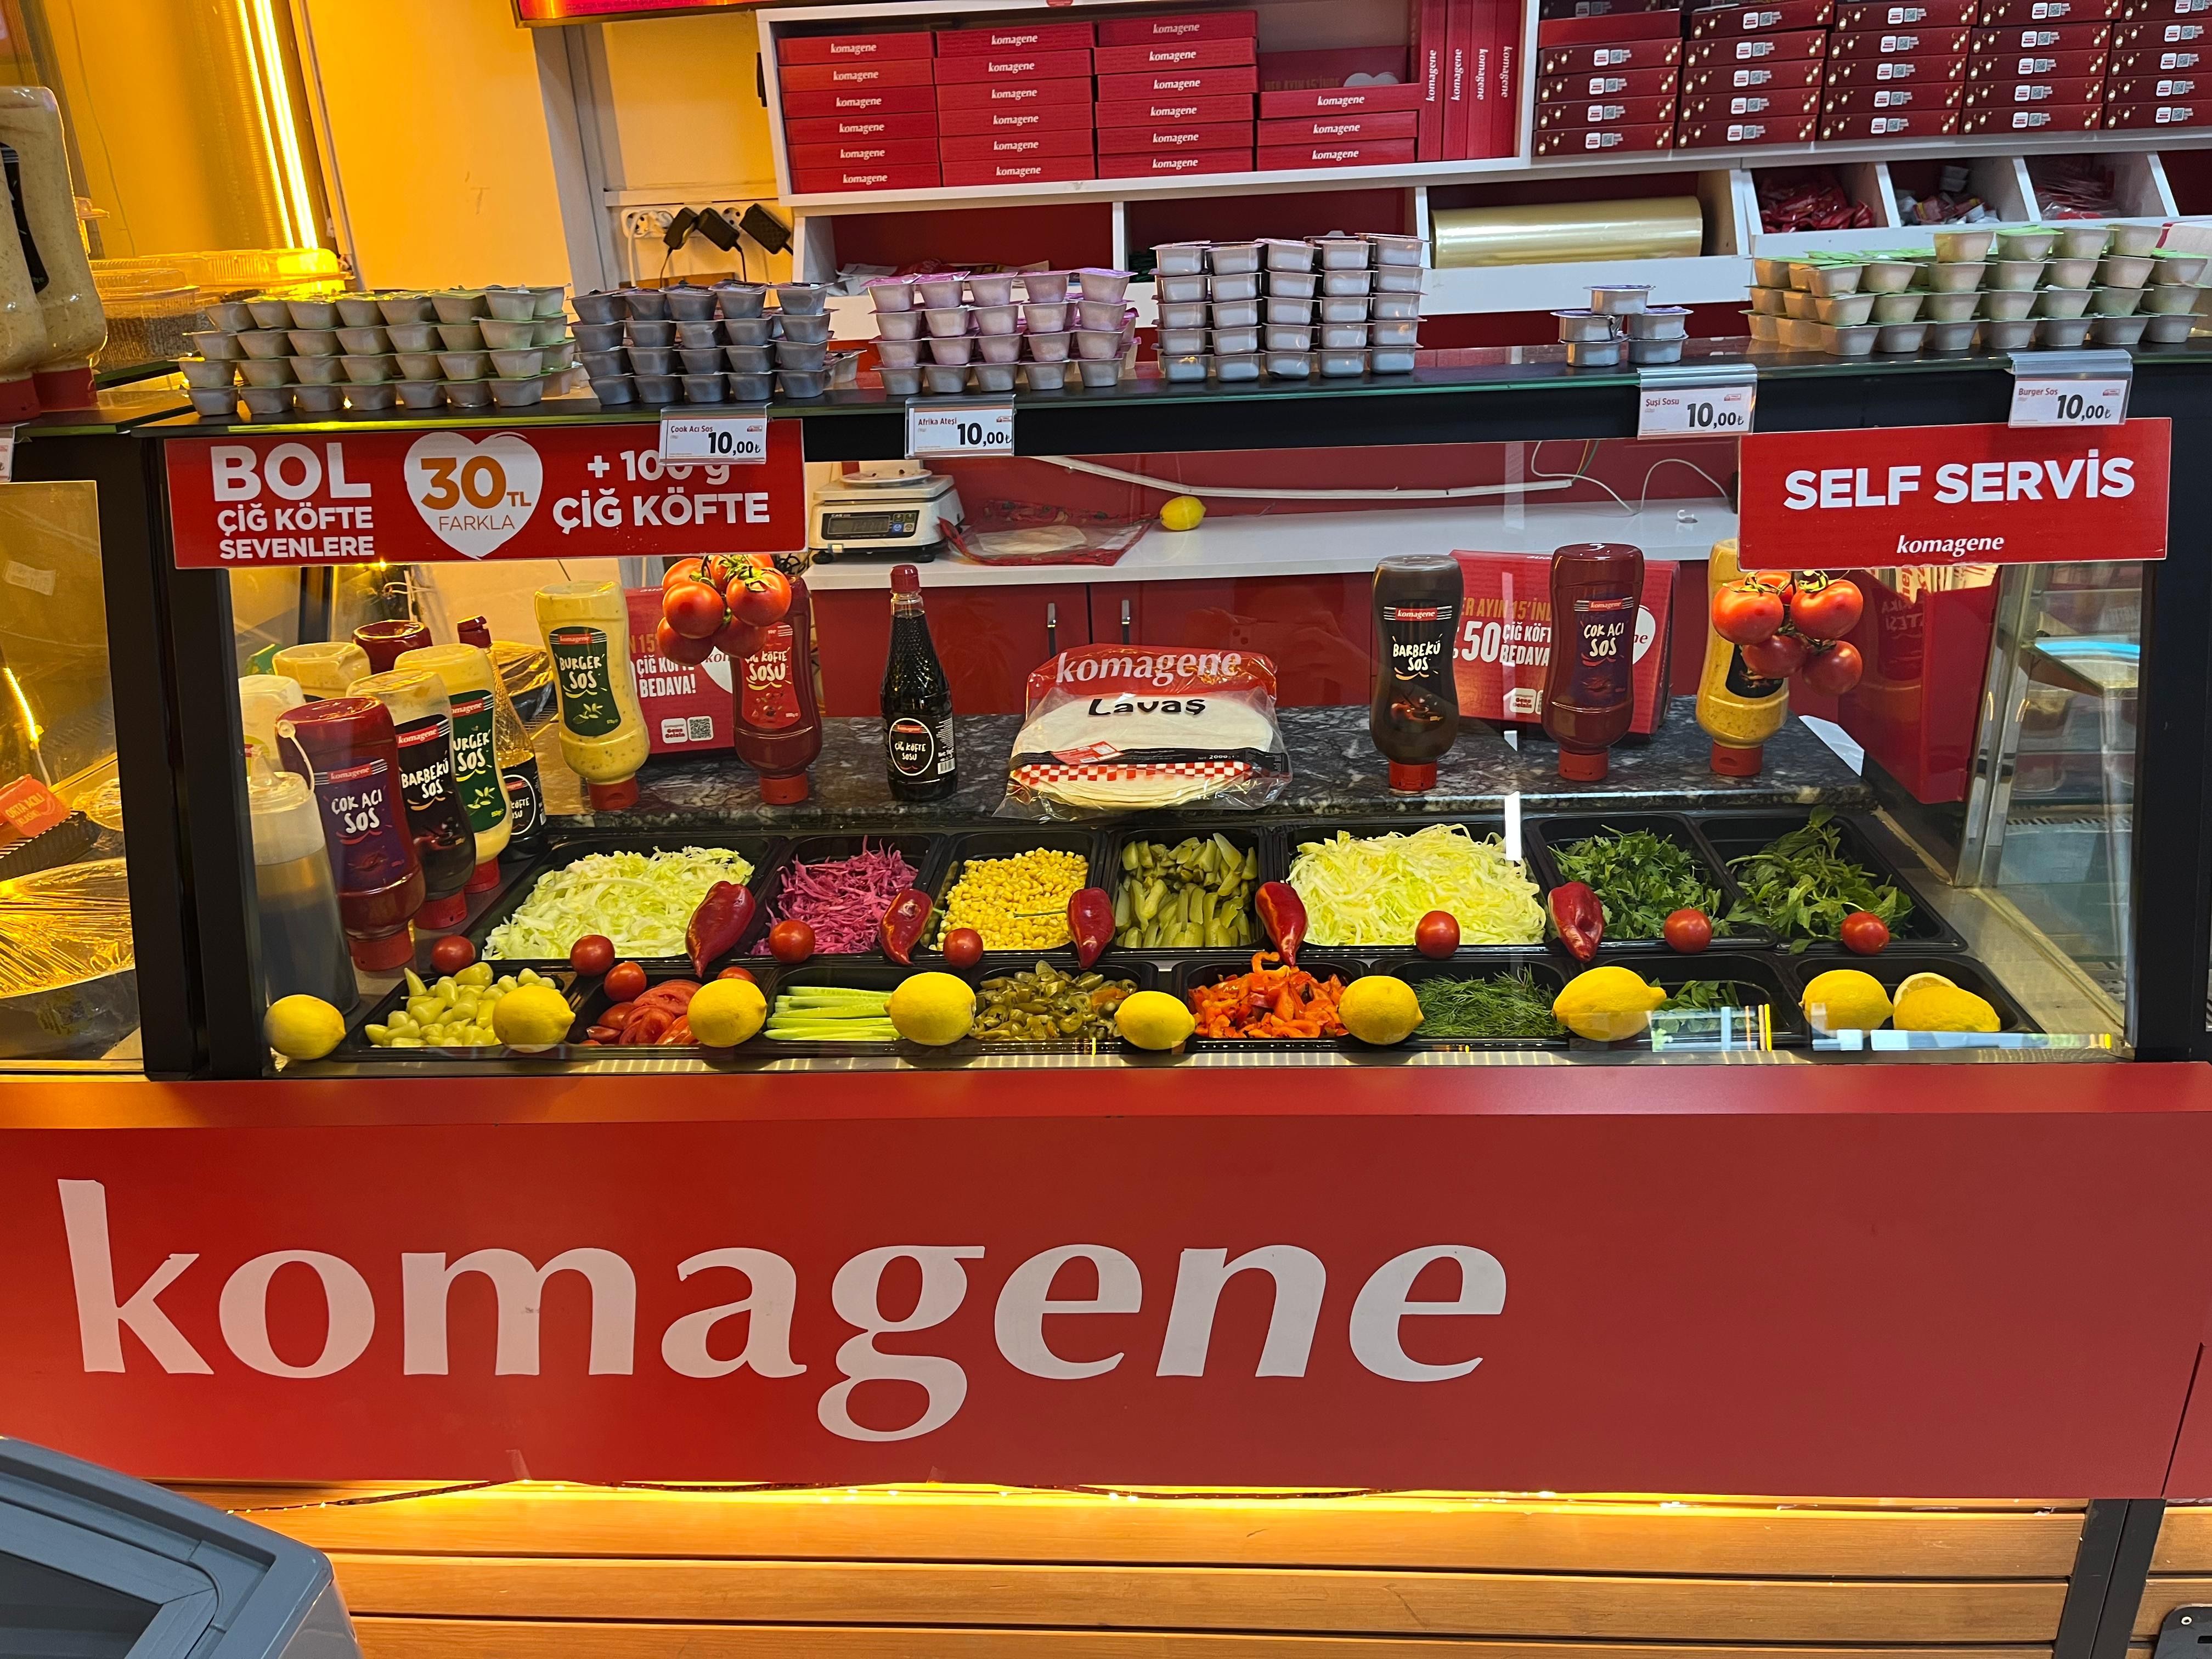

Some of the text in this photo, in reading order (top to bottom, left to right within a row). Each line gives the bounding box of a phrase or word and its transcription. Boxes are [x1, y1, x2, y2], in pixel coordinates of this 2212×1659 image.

[1153, 24, 1200, 35] komagene
[991, 35, 1038, 47] komagene
[831, 43, 877, 55] komagene
[1149, 51, 1197, 63] komagene
[988, 62, 1035, 74] komagene
[1425, 49, 1438, 101] komagene
[1451, 49, 1463, 100] komagene
[1475, 48, 1488, 100] komagene
[1499, 46, 1513, 98] komagene
[833, 71, 879, 82] komagene
[1153, 79, 1201, 91] komagene
[991, 89, 1037, 100] komagene
[1317, 95, 1365, 108] komagene
[836, 97, 882, 109] komagene
[1150, 106, 1197, 118] komagene
[993, 115, 1039, 127] komagene
[839, 123, 885, 135] komagene
[1313, 124, 1361, 136] komagene
[993, 140, 1039, 152] komagene
[1153, 133, 1199, 145] komagene
[840, 149, 885, 160] komagene
[1312, 150, 1359, 161] komagene
[996, 166, 1041, 178] komagene
[1152, 159, 1198, 170] komagene
[843, 174, 888, 185] komagene
[2018, 388, 2044, 397] Burger
[211, 442, 372, 501] BOL
[1783, 449, 2135, 510] SELF SERVİS
[552, 487, 770, 535] ÇİĞ KÖFTE
[217, 502, 374, 537] ÇİĞ KÖFTE
[439, 515, 516, 532] FARKLA
[219, 536, 375, 560] SEVENLERE
[1897, 534, 2005, 557] komagene
[1590, 601, 1622, 610] komagene
[1397, 610, 1436, 619] komagene
[1502, 621, 1551, 643] ÇİĞ KÖFT
[1583, 622, 1624, 640] ÇOK ACI
[1393, 640, 1441, 658] BARBEKÜ
[1589, 637, 1617, 657] SOS
[560, 656, 602, 671] BURGER
[761, 650, 788, 663] KÖFTE
[1407, 657, 1429, 671] SOS
[636, 654, 657, 678] ÇİĞ
[749, 663, 786, 681] SOSU
[1056, 651, 1242, 687] komagene
[569, 670, 597, 690] SOS
[639, 674, 696, 698] BEDAVA!
[452, 702, 483, 715] omagene
[1088, 698, 1206, 716] Lavaş
[398, 728, 437, 744] komagene
[453, 732, 490, 751] URGER
[905, 742, 926, 753] KÖFTE
[458, 748, 486, 772] SOS
[330, 767, 370, 780] komagene
[401, 759, 449, 788] BARBEKÜ
[421, 779, 444, 799] SOS
[331, 789, 383, 815] ÇOK ACI
[5, 802, 28, 819] ORTA
[344, 808, 380, 834] SOS
[57, 1178, 1508, 1442] komagene
